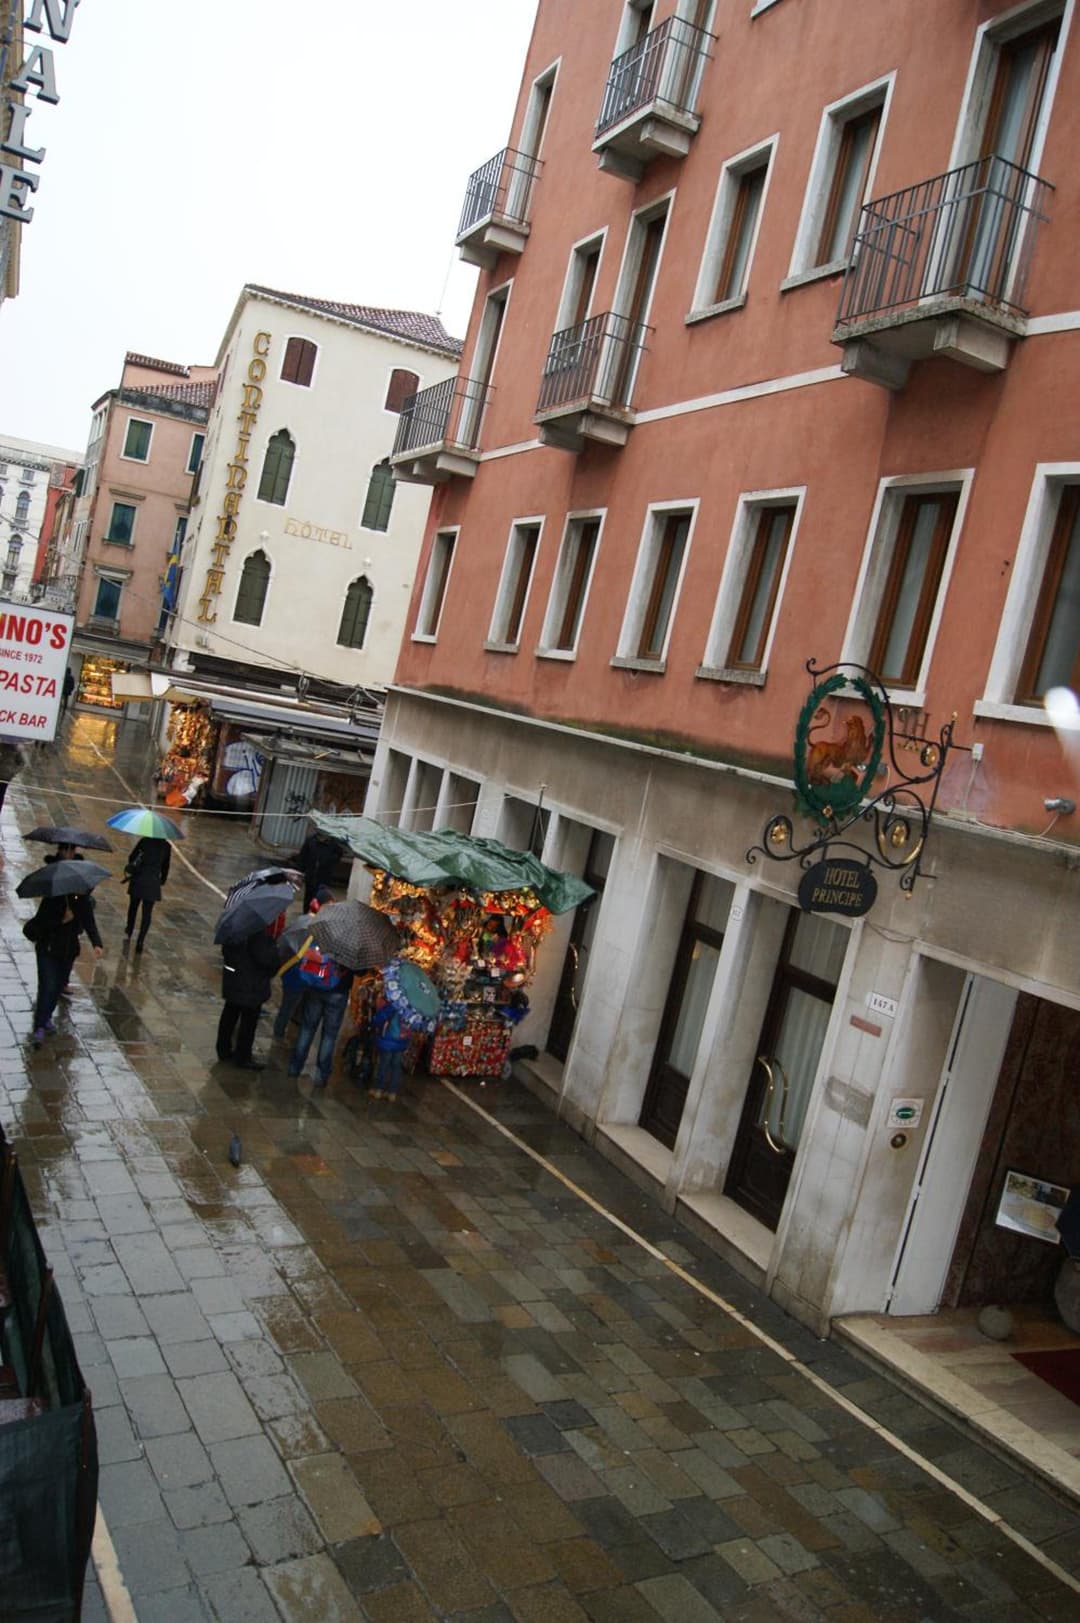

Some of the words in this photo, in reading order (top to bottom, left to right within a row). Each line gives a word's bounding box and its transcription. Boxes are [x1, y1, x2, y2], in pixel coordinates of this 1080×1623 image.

[24, 652, 43, 664] 1972
[0, 669, 57, 698] PASTA
[18, 713, 48, 728] BAR
[823, 867, 861, 888] HOTEL
[811, 887, 865, 907] PRINCIPE
